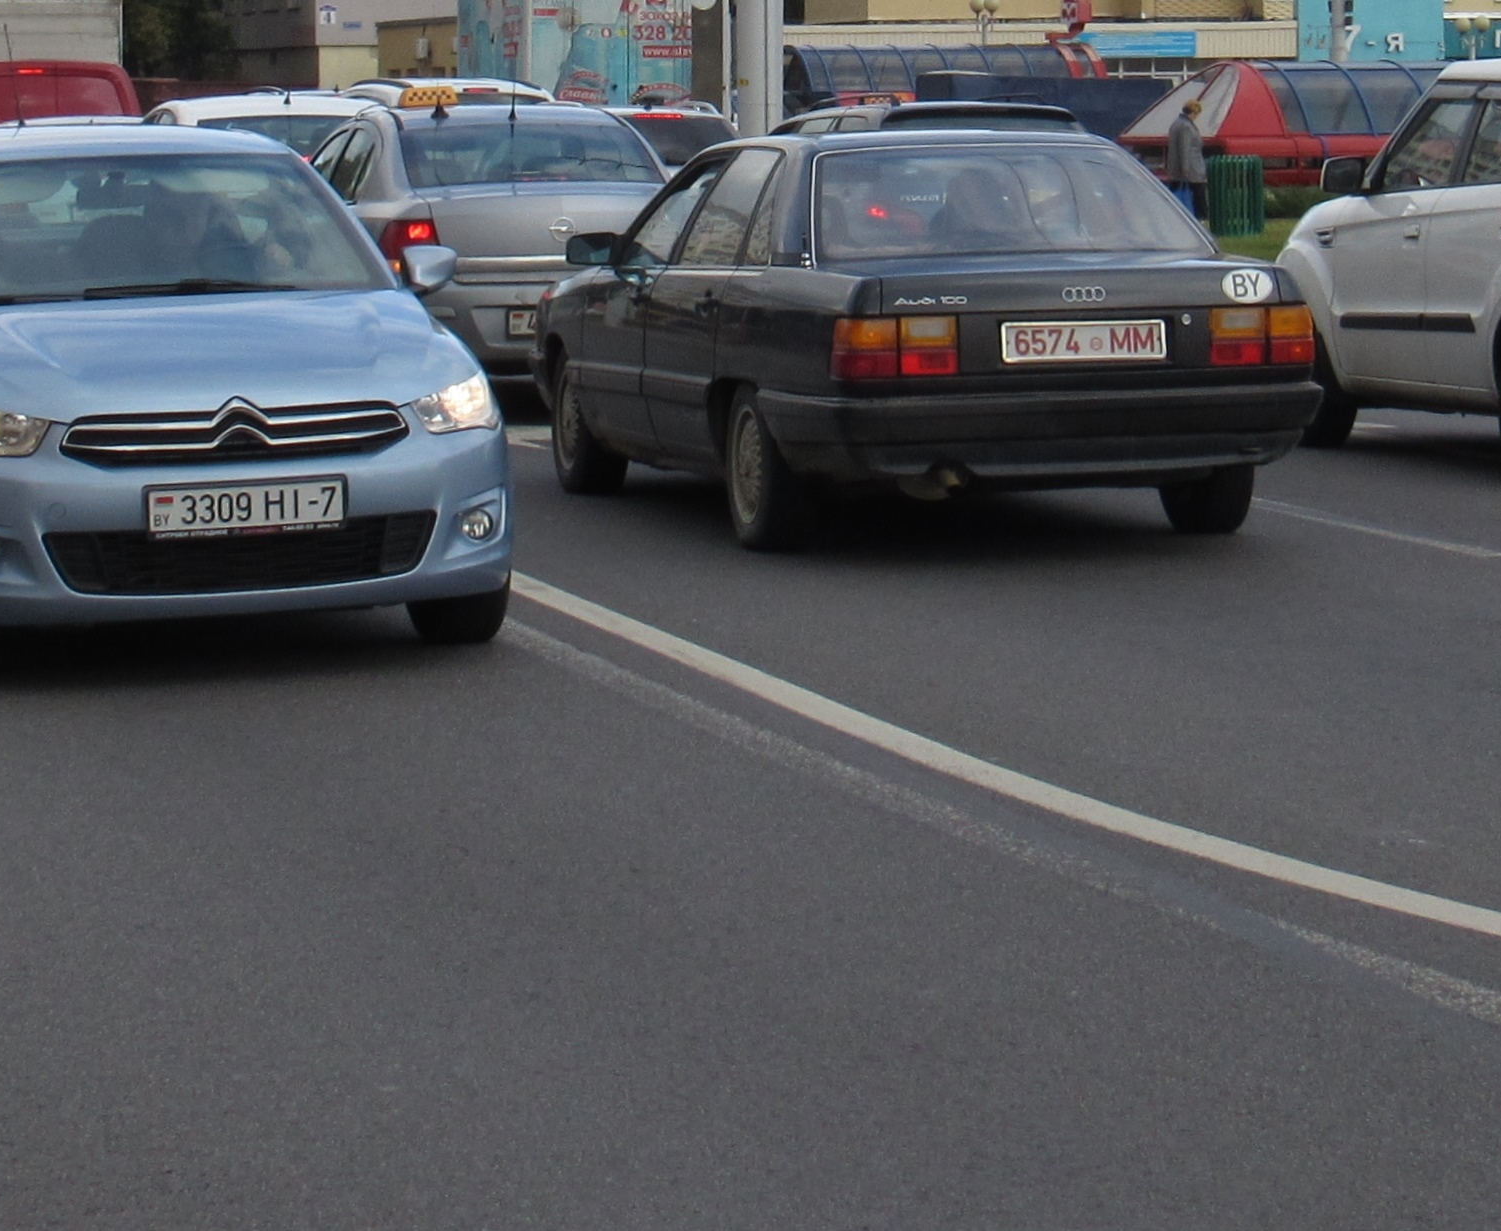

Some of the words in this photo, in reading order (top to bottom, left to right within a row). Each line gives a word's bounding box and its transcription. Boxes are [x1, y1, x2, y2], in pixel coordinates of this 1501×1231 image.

[633, 25, 667, 41] 328
[1231, 273, 1261, 298] BY
[894, 297, 936, 306] Audi
[940, 295, 968, 305] 100
[1014, 328, 1080, 355] 6574
[1110, 326, 1156, 353] MM
[181, 491, 252, 524] 3309
[153, 513, 170, 527] BY
